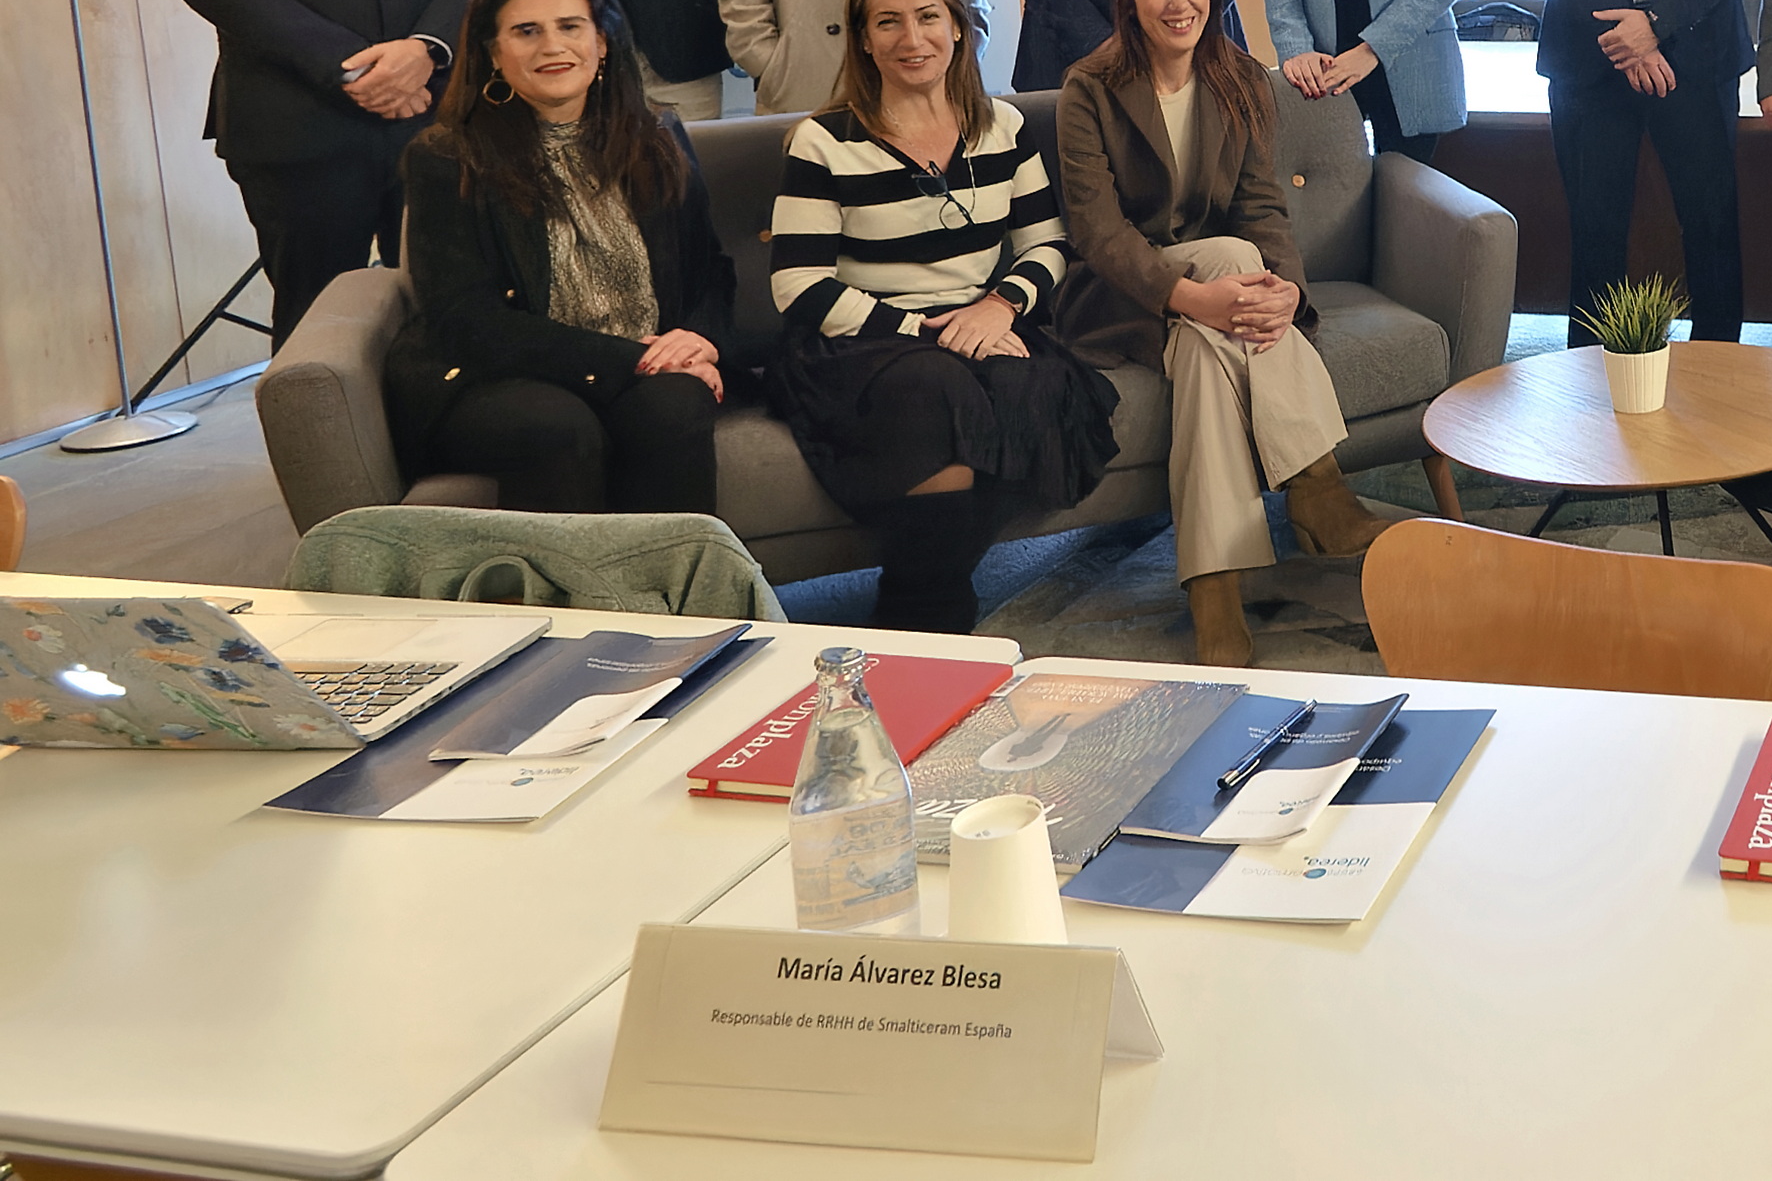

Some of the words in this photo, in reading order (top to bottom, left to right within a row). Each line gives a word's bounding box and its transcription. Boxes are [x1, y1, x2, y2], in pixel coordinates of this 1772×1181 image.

[777, 957, 843, 981] María
[849, 954, 934, 986] Álvarez
[942, 965, 1002, 989] Blesa
[711, 1009, 793, 1027] Responsable
[797, 1014, 813, 1028] de
[816, 1014, 854, 1030] RRHH
[858, 1017, 874, 1032] de
[878, 1018, 961, 1036] Smalticeram
[965, 1022, 1013, 1040] España
